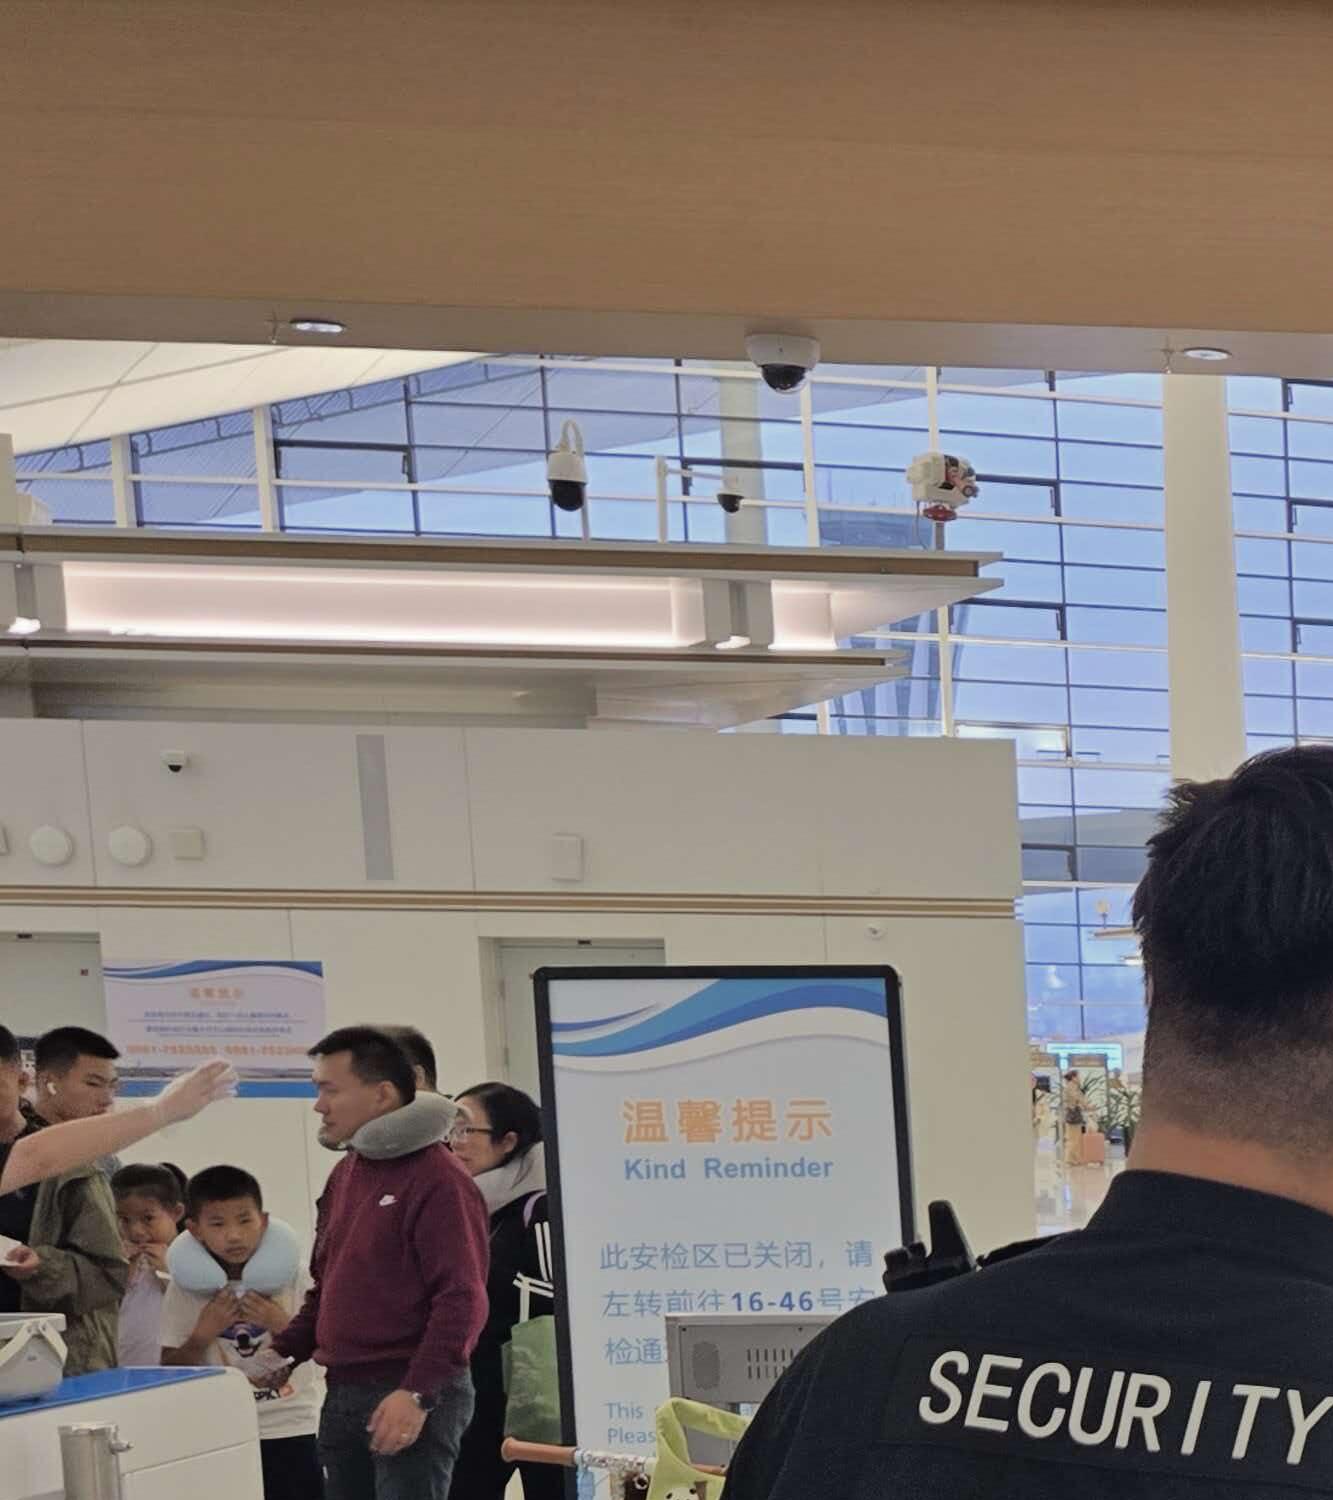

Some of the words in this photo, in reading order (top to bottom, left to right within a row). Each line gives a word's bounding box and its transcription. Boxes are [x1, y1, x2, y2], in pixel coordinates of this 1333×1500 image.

[622, 1098, 833, 1143] 温馨提示
[624, 1157, 687, 1180] Kind
[704, 1156, 834, 1179] Reminder
[604, 1337, 668, 1365] 检通
[607, 1402, 643, 1419] This
